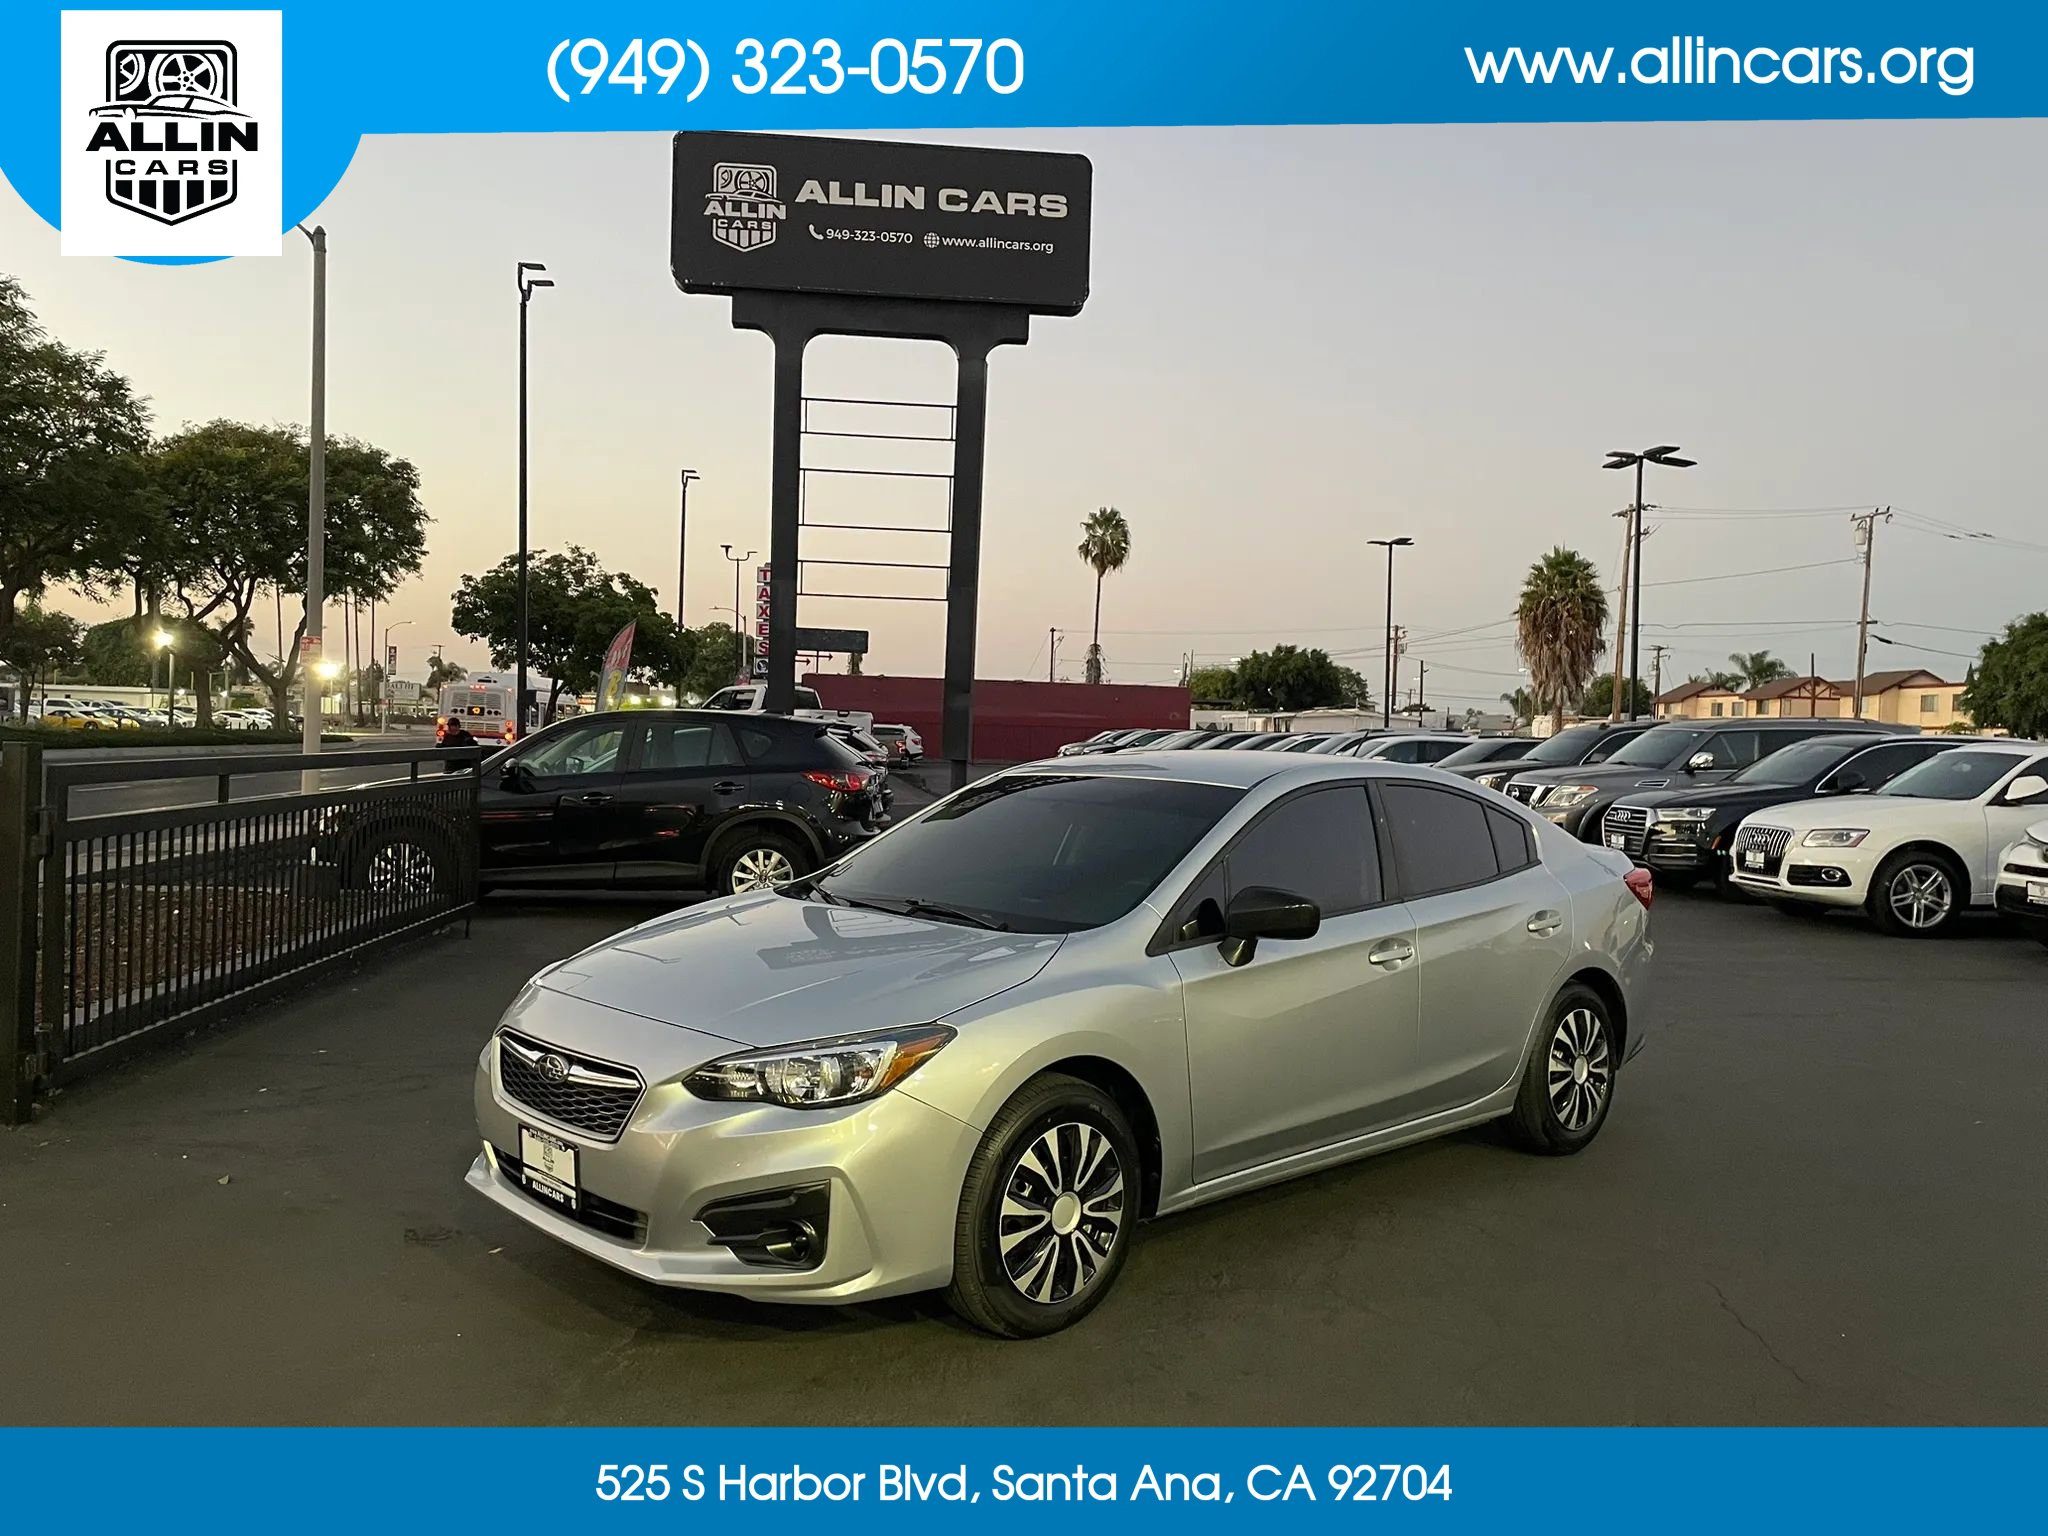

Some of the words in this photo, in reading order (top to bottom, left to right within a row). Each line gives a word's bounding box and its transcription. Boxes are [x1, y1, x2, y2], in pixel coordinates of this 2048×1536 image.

[794, 179, 925, 210] ALLIN
[938, 188, 1068, 218] CARS
[703, 200, 787, 220] ALLIN
[717, 218, 772, 230] CARS
[825, 228, 913, 244] 949-323-0570
[941, 235, 1054, 255] www.allincars.org
[758, 569, 771, 655] TAXES
[532, 1181, 564, 1203] ALLINCARS
